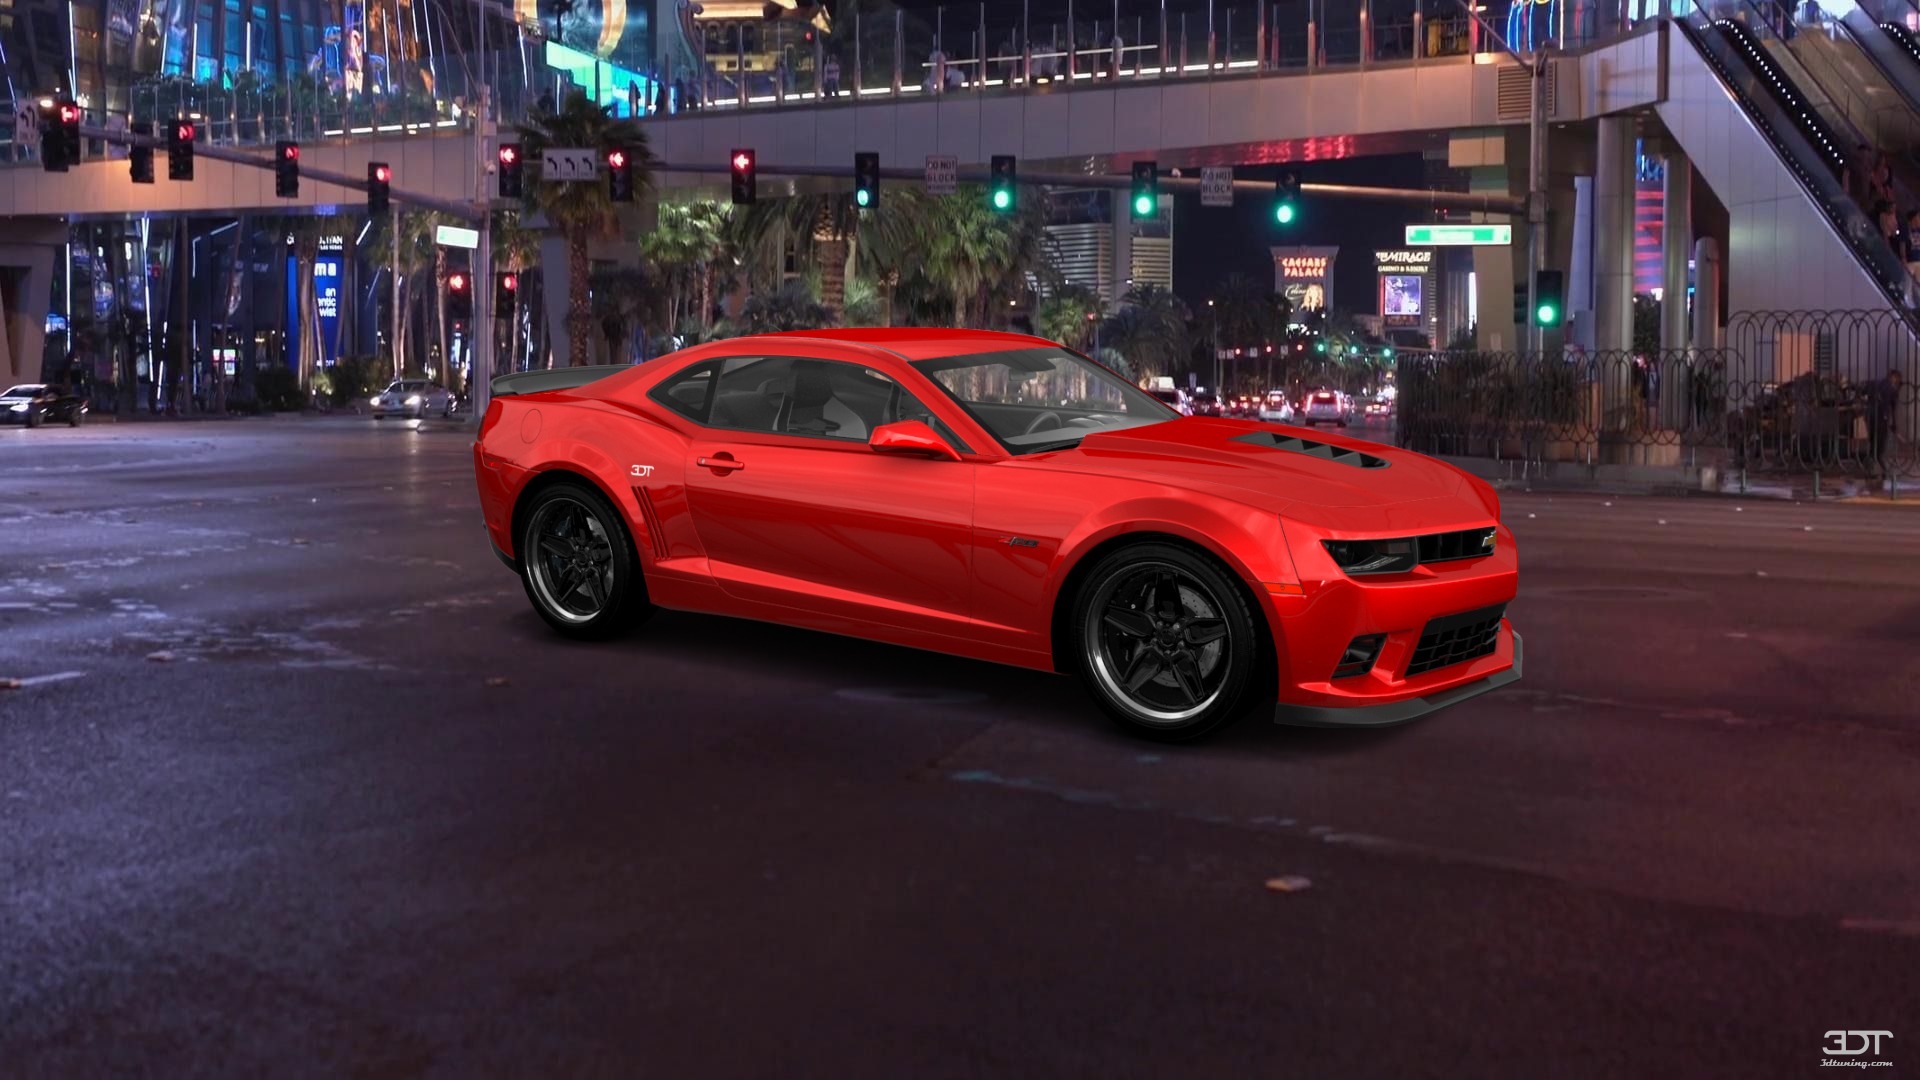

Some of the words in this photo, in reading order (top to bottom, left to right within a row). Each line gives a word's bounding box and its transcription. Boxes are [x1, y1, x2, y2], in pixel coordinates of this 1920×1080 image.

[928, 173, 956, 182] BLOCK
[1202, 183, 1231, 193] BLOCK
[1282, 257, 1327, 267] CAESARS
[1386, 251, 1431, 263] MIRAGE
[1284, 268, 1325, 277] PALACE
[631, 465, 655, 477] 3DT
